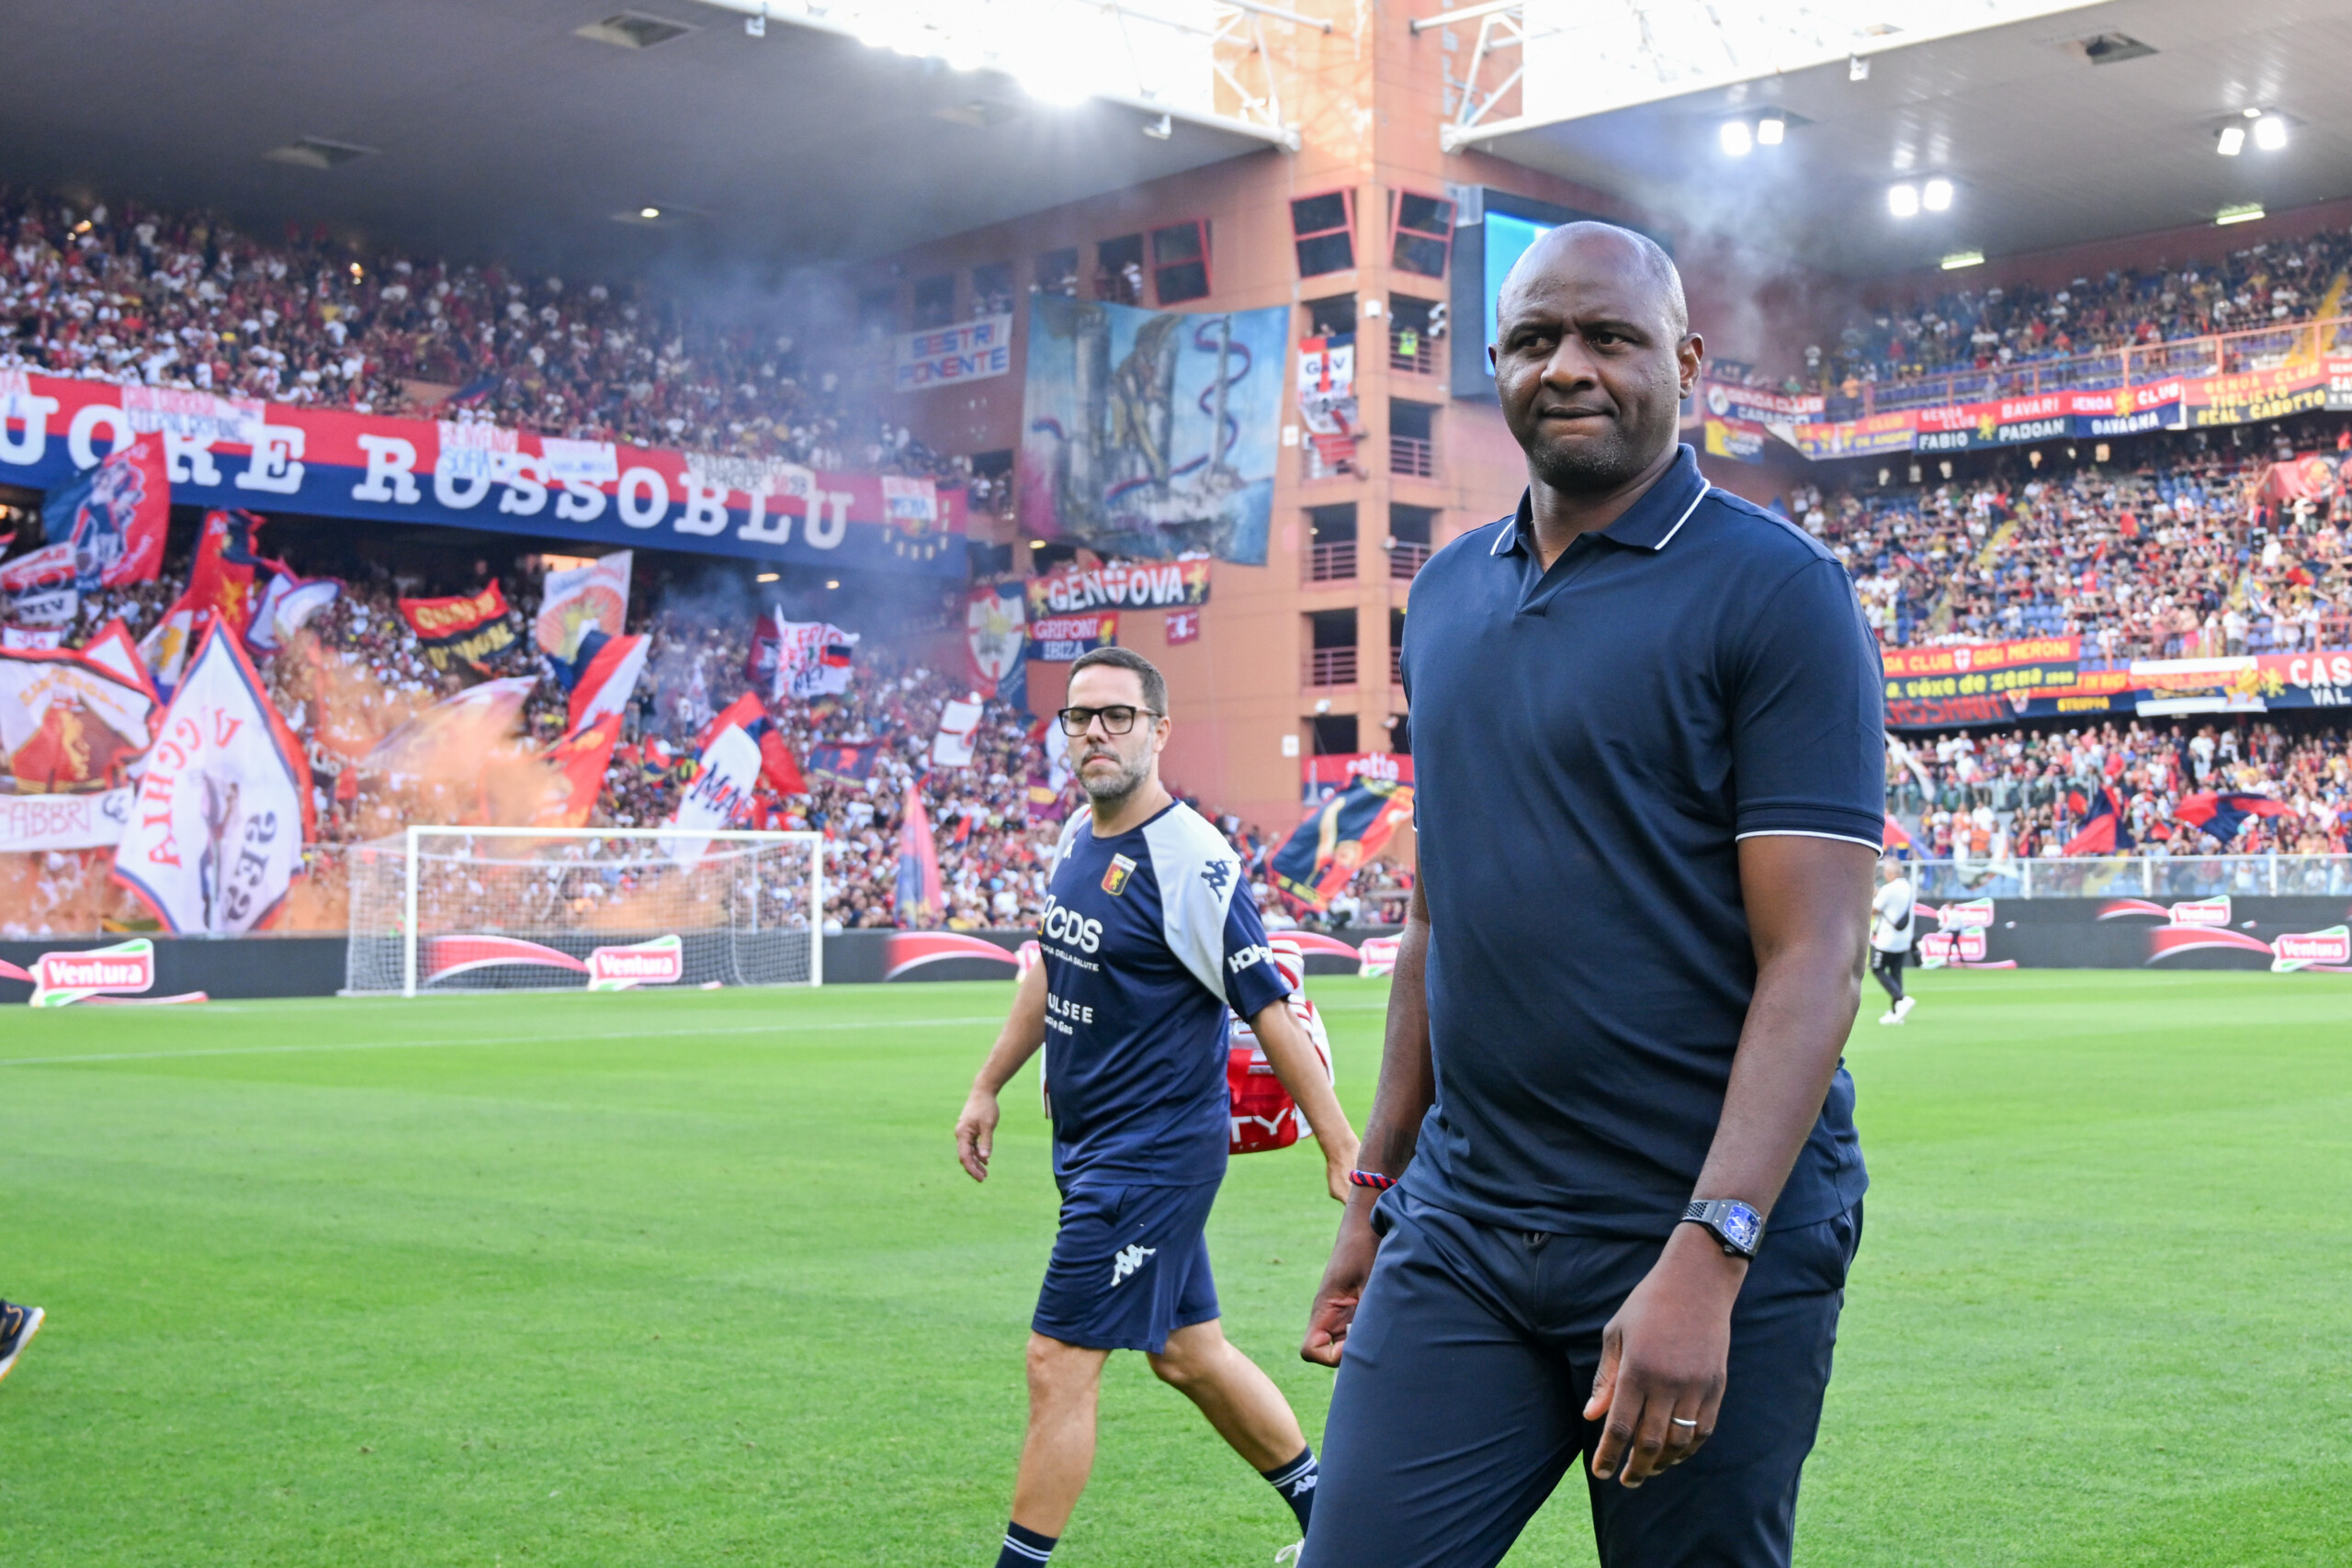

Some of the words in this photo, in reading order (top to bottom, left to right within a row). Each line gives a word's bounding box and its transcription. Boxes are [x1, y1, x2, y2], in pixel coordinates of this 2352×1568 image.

[912, 323, 994, 358] SESTRI
[897, 345, 1008, 384] PONENTE
[2203, 376, 2261, 395] GENOA
[2273, 360, 2321, 384] CLUB
[2137, 381, 2179, 406] CLUB
[1920, 407, 1963, 423] GENOA
[2001, 395, 2060, 420] BAVARI
[1918, 431, 1969, 450] FABIO
[351, 434, 855, 551] ROSSOBLU
[1035, 617, 1098, 640] GRIFONI
[1043, 640, 1085, 660] IBIZA
[1909, 653, 1952, 671] CLUB
[1973, 647, 2004, 666] GIGI
[2007, 640, 2071, 660] MERONI
[2282, 939, 2344, 957] Ventura
[48, 960, 143, 986] Ventura
[597, 951, 675, 978] Ventura
[1073, 956, 1100, 973] SALUTE
[1058, 1021, 1074, 1036] Gas
